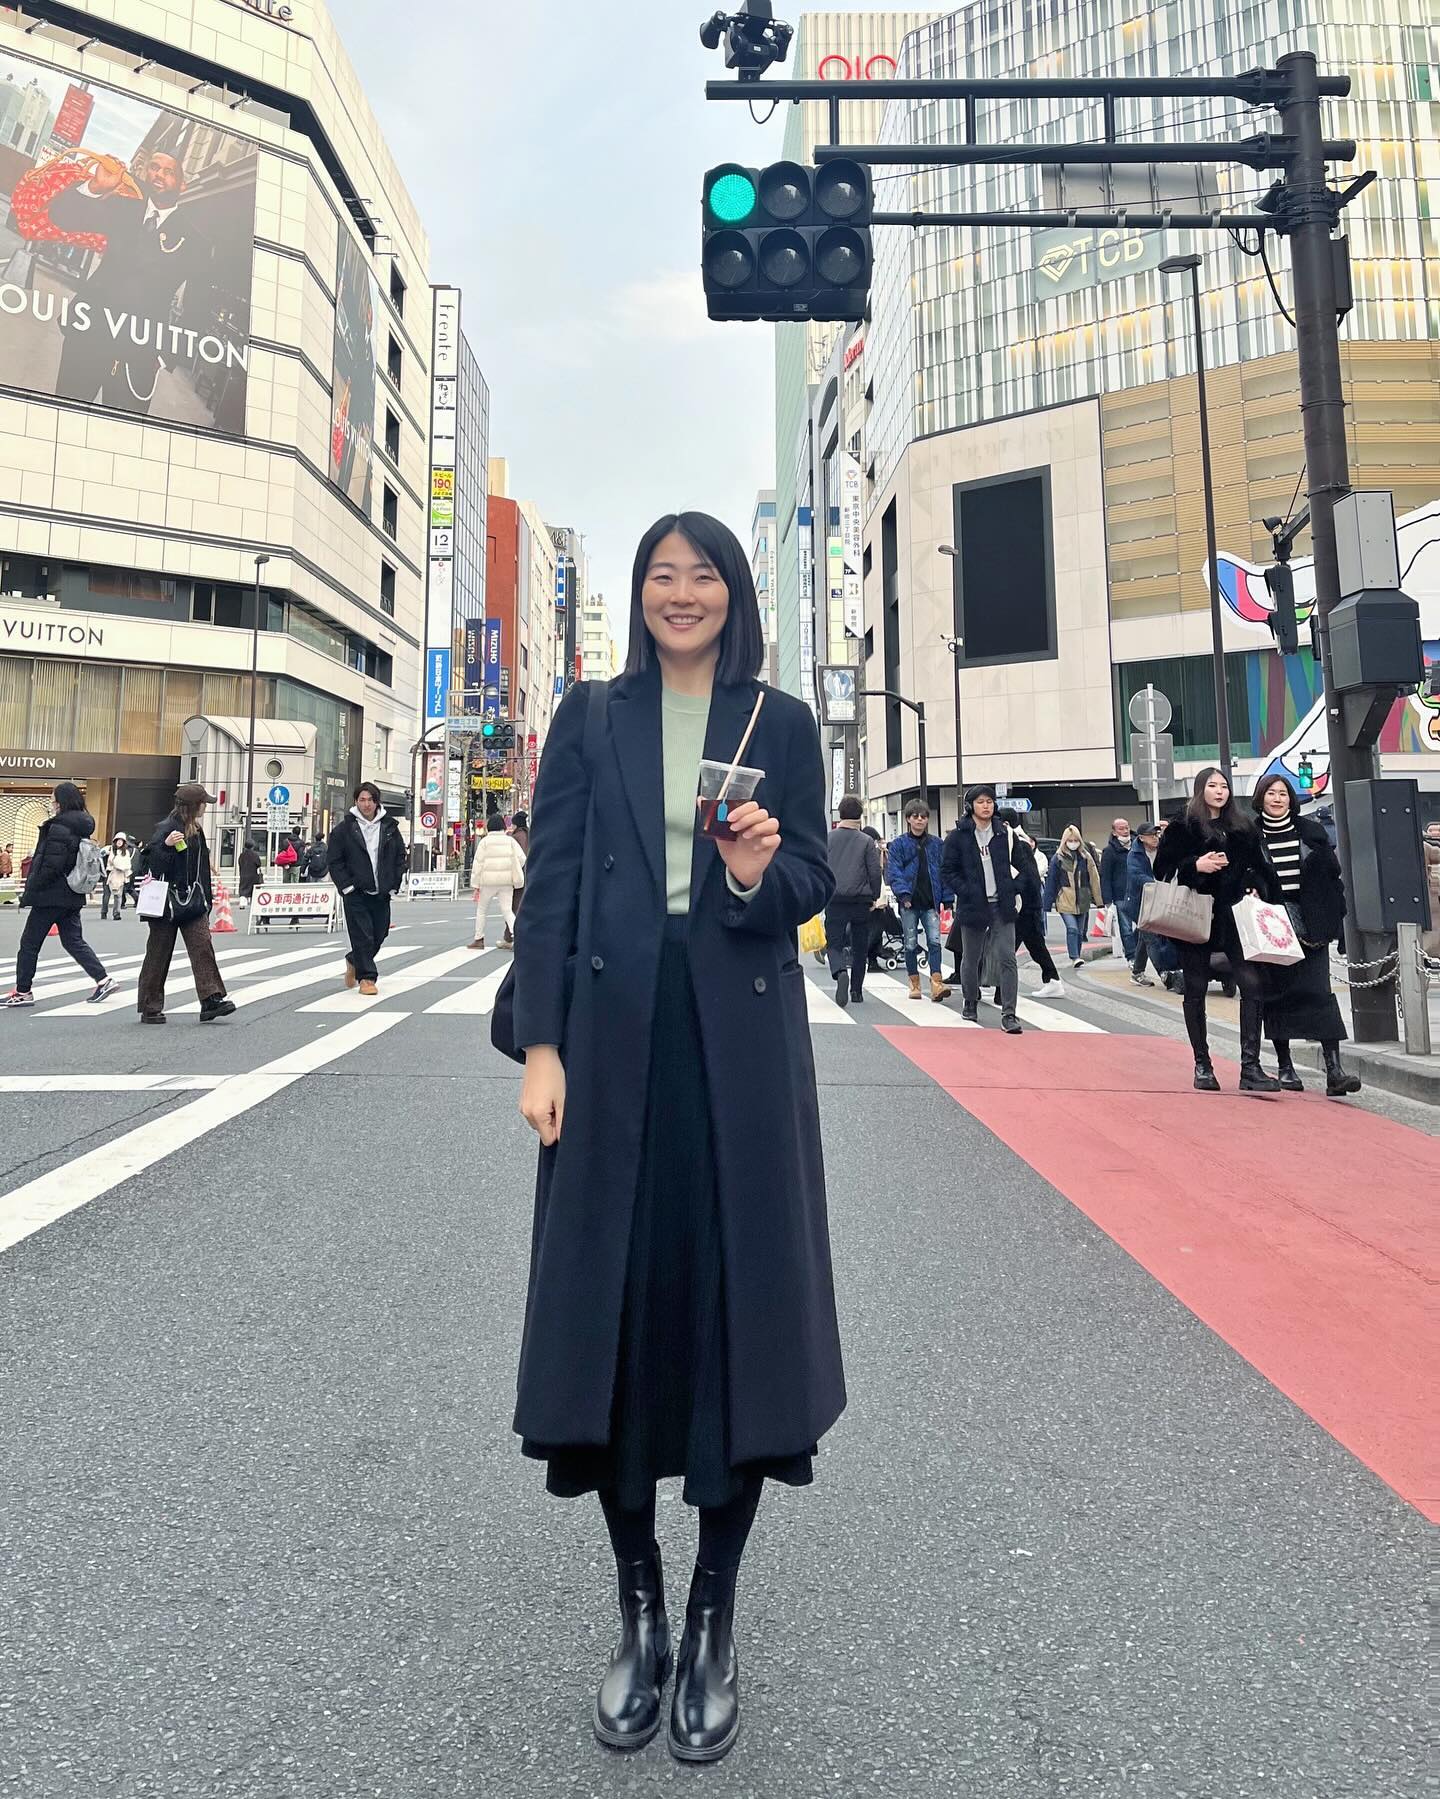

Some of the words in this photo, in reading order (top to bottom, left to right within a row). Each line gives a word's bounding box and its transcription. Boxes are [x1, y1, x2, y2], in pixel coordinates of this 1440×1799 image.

[1073, 228, 1144, 275] TCB
[104, 307, 249, 372] VUITTON
[438, 304, 456, 361] frente
[845, 480, 858, 488] TCB
[3, 619, 104, 647] VUITTON
[490, 629, 499, 664] MIZUHO
[273, 892, 330, 905] 車両通行止め
